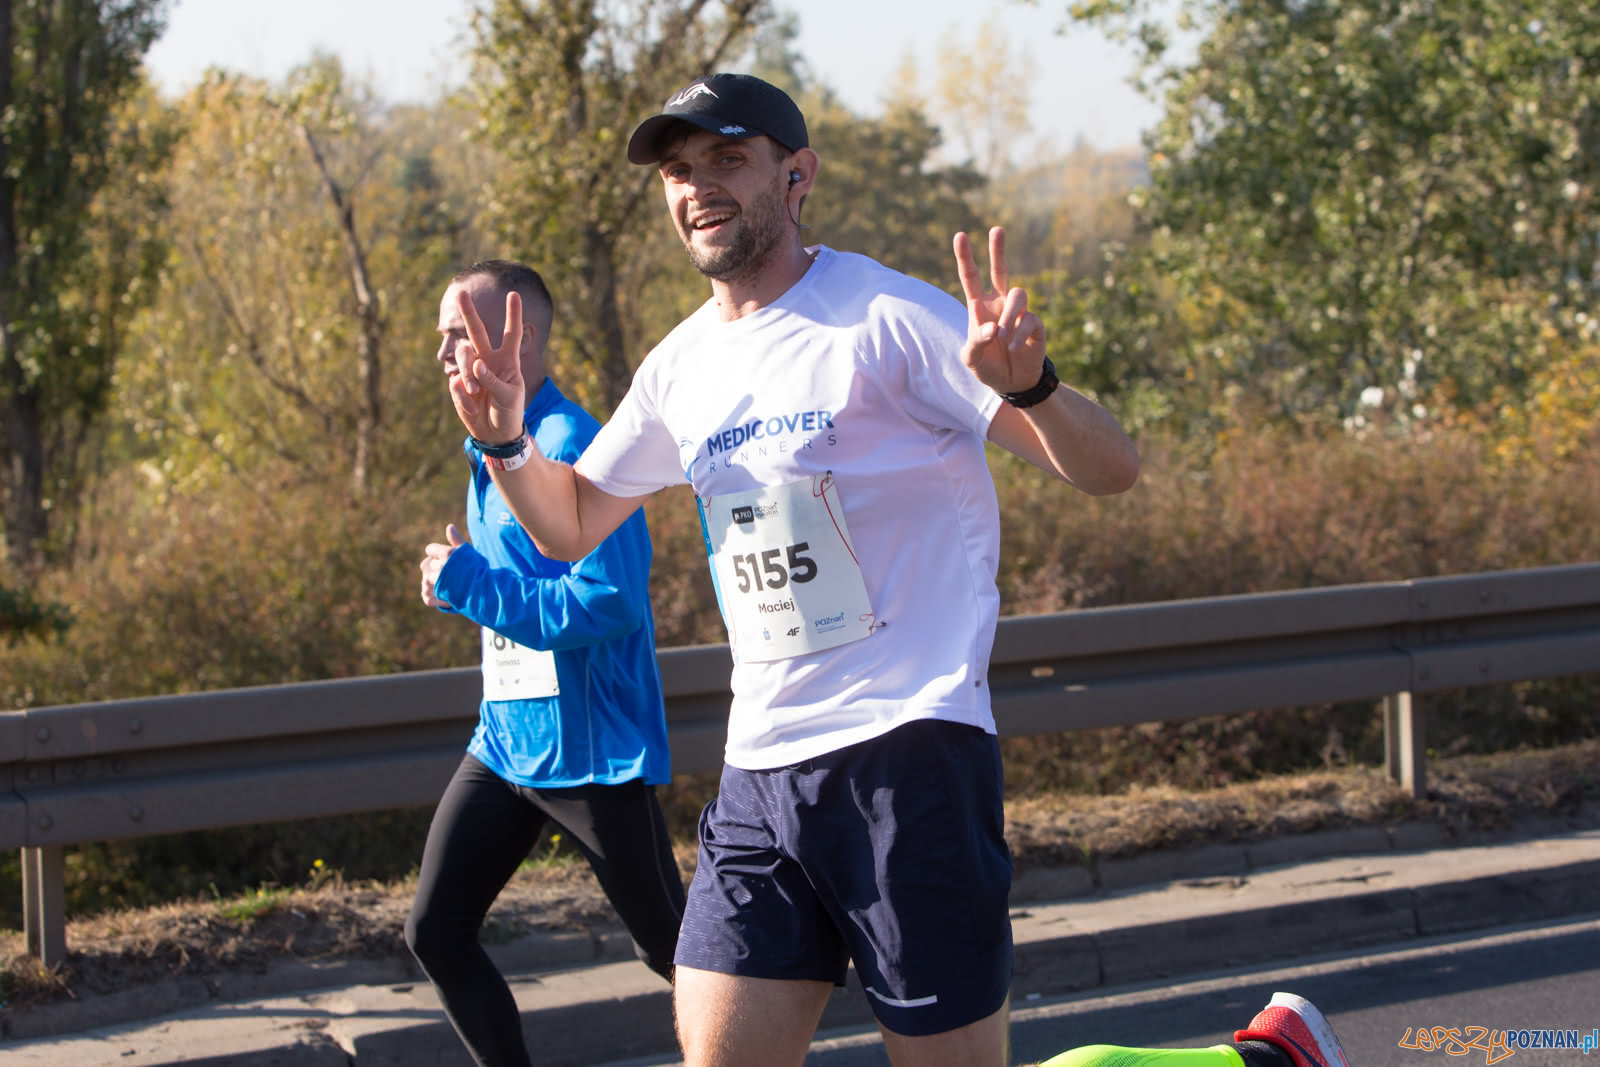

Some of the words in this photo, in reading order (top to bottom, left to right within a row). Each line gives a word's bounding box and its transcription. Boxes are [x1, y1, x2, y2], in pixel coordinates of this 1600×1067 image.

[707, 410, 834, 456] MEDICOVER
[709, 434, 837, 474] RUNNERS
[732, 542, 818, 594] 5155
[758, 598, 796, 614] Maciej
